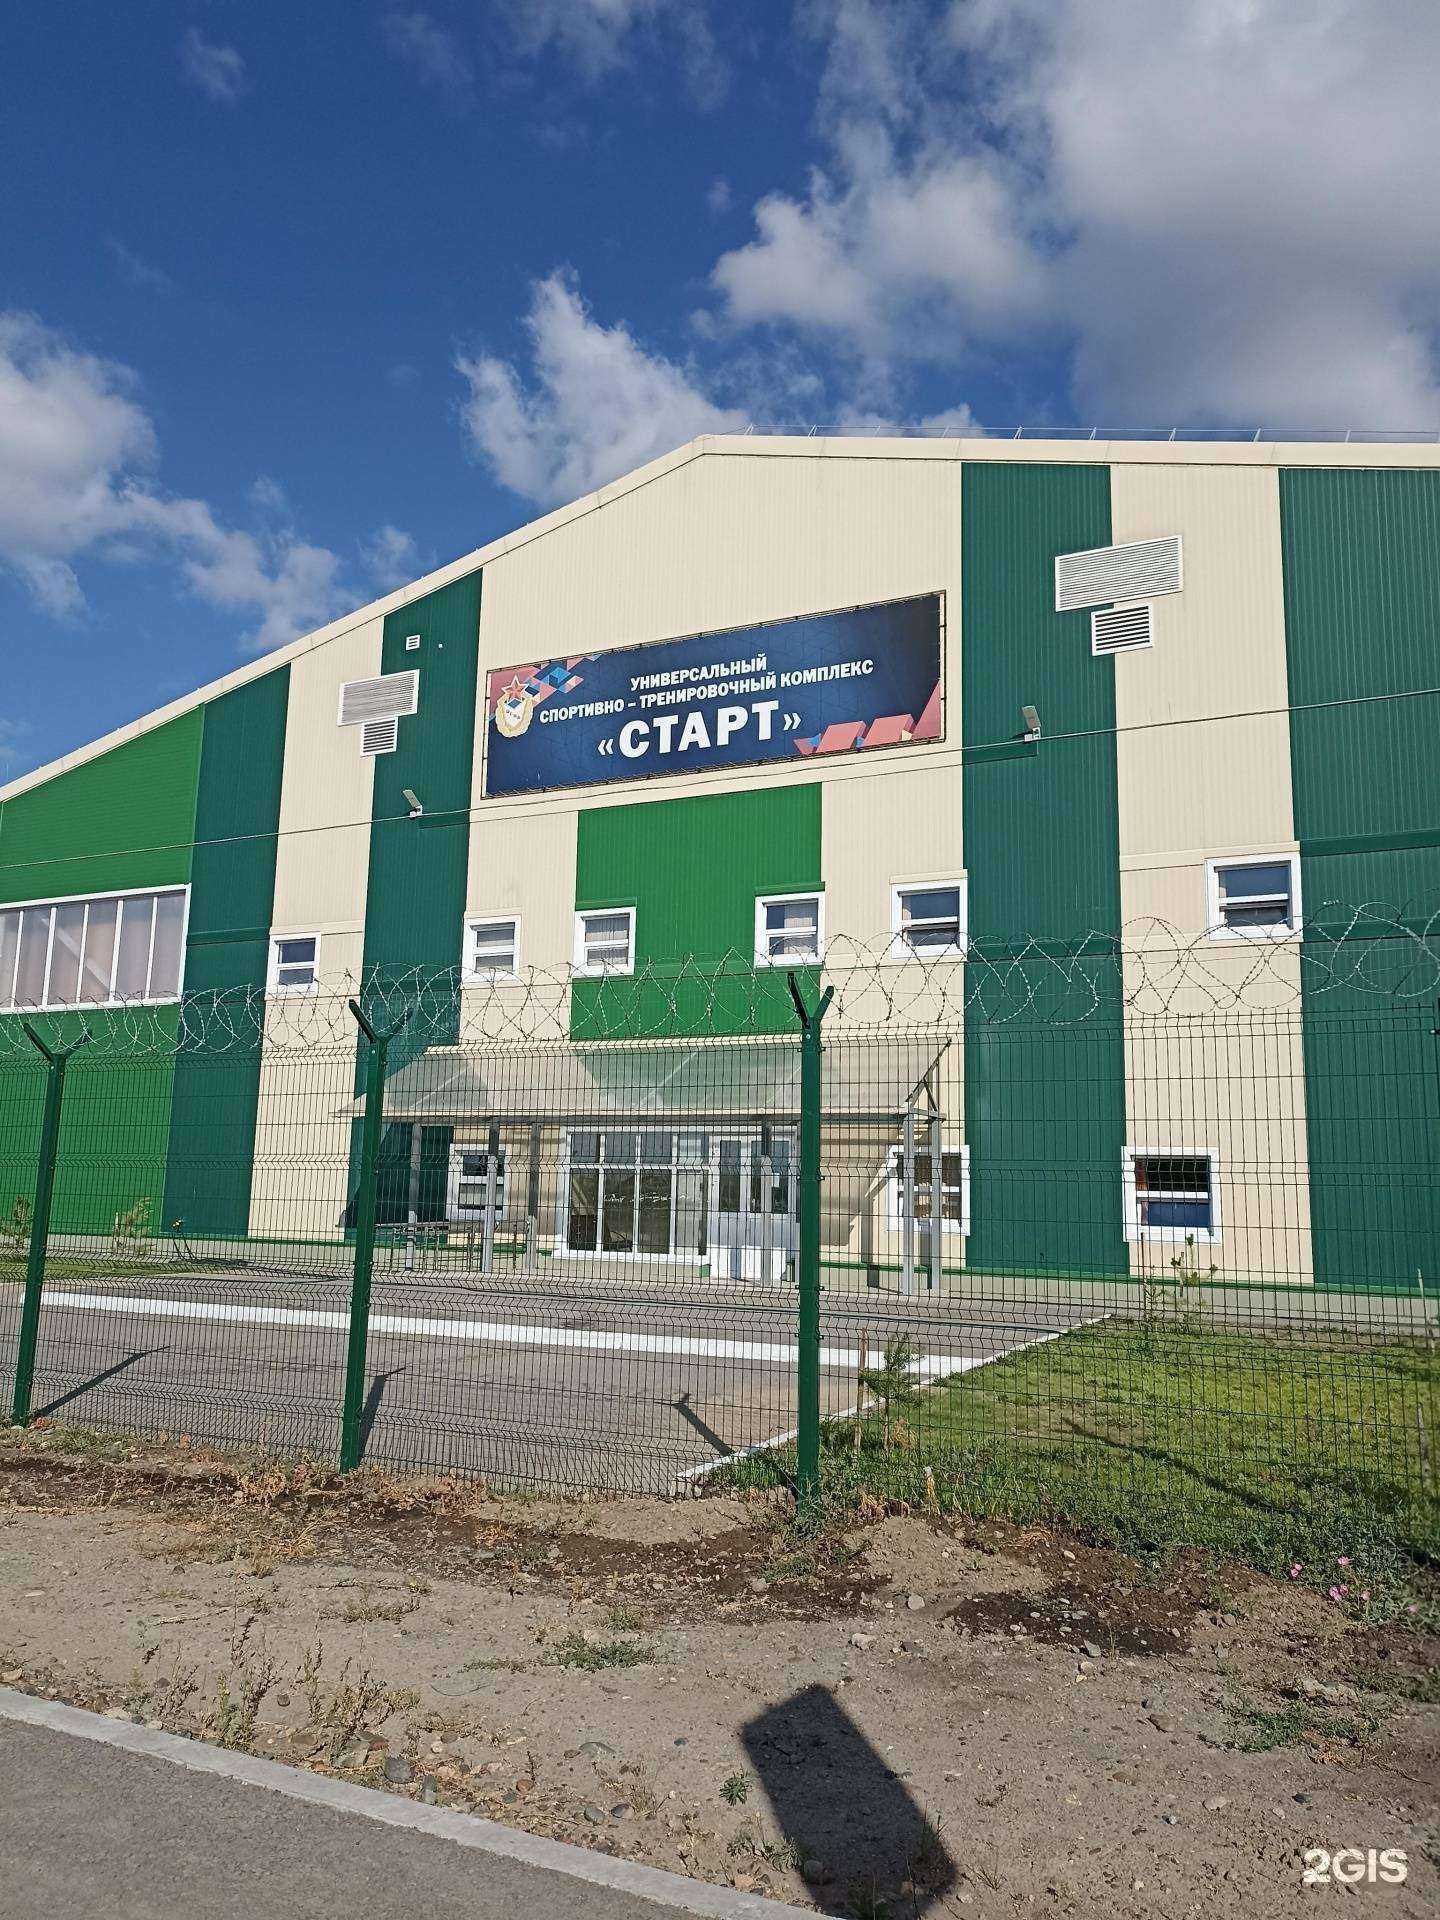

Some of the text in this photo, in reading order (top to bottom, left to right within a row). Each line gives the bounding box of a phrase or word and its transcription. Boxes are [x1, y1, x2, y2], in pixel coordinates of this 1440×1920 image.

[539, 699, 624, 723] СПОРТИВНО
[640, 671, 777, 709] ТРЕНИРОВОЧНЫЙ
[780, 659, 874, 687] КОМПЛЕКС
[630, 653, 767, 691] УНИВЕРСАЛЬНЫЙ
[597, 700, 802, 758] «СТАРТ»
